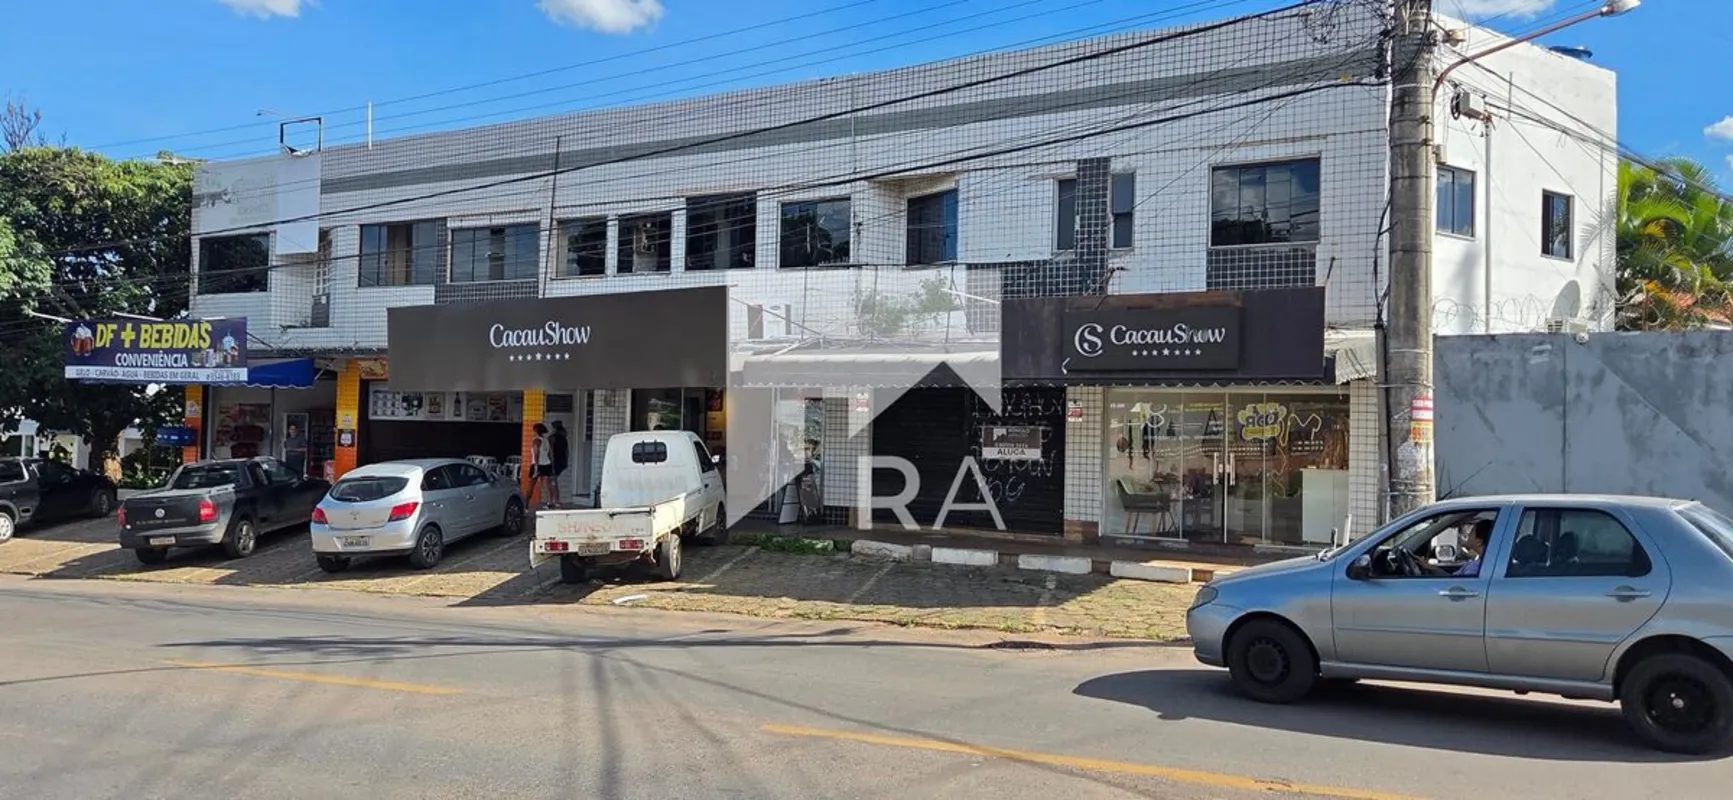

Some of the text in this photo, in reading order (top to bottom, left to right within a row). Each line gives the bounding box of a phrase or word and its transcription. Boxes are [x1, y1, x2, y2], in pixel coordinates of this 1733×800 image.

[95, 322, 213, 349] DF + BEBIDAS
[489, 320, 591, 348] CacauShow
[1110, 322, 1226, 345] CacauShow
[115, 350, 189, 367] CONVENIÊNCIA
